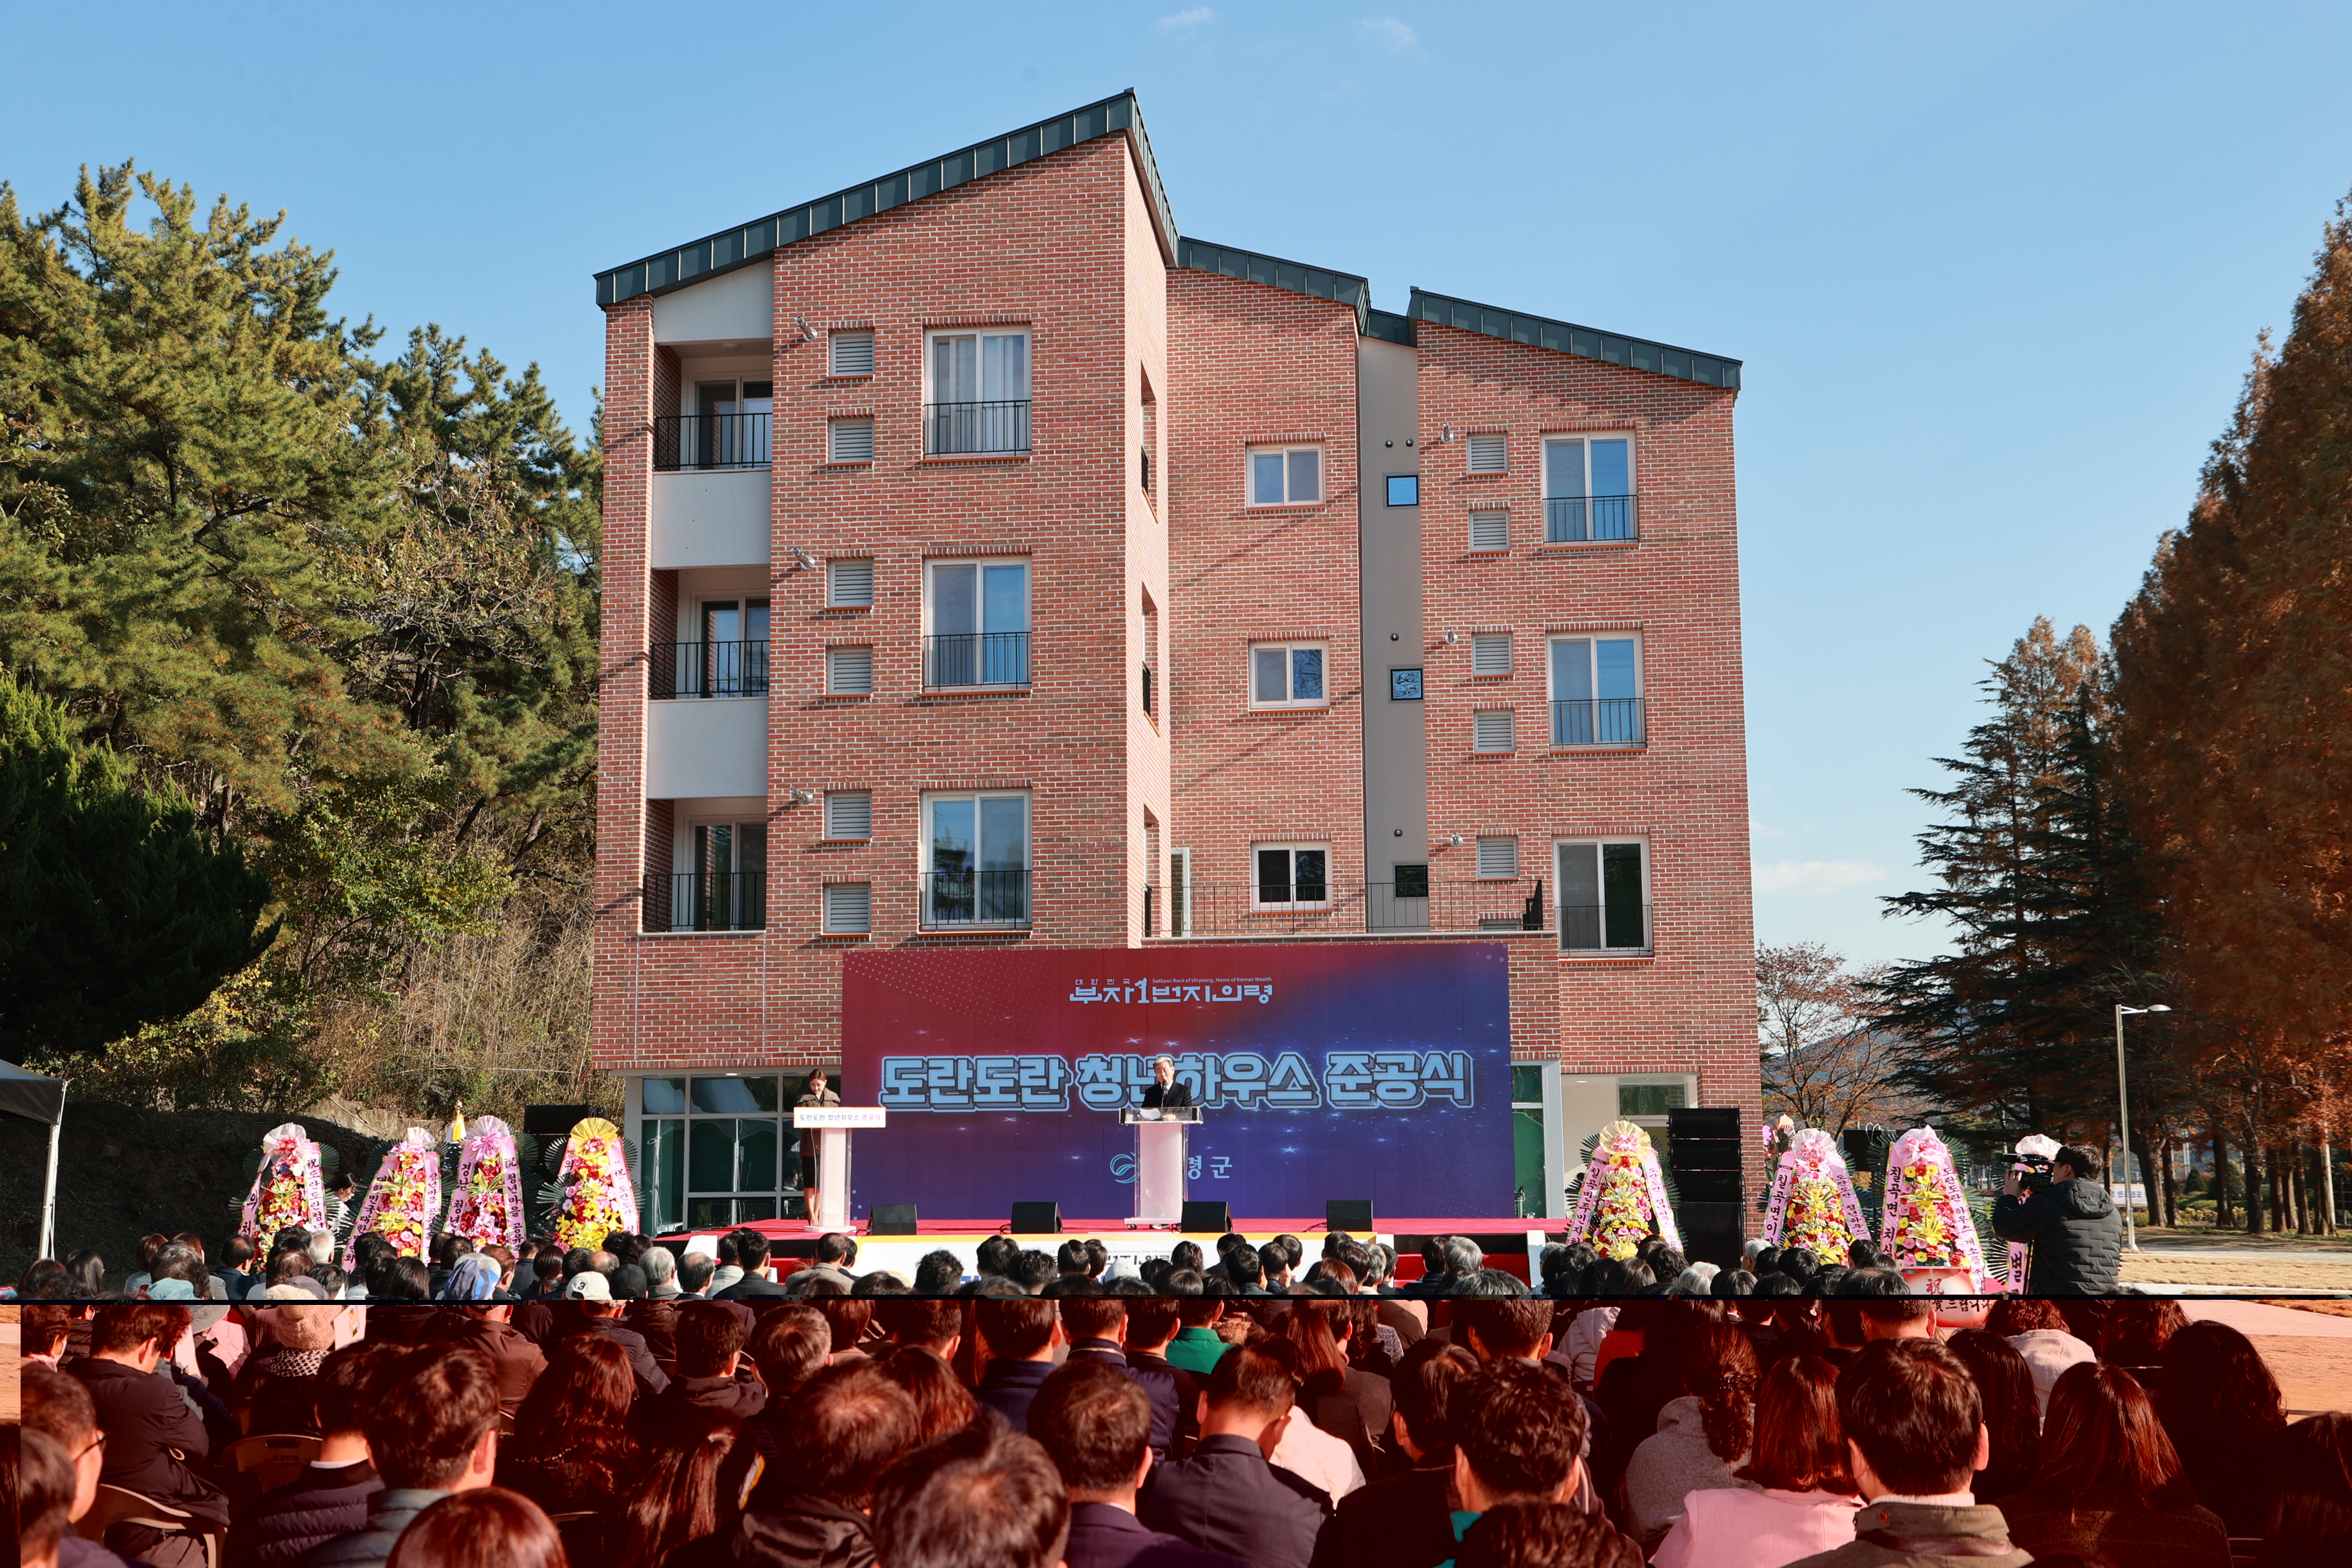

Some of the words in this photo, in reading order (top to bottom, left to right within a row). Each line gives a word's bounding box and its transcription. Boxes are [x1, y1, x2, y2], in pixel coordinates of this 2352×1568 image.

[878, 1055, 1074, 1112] 도란도란
[1324, 1050, 1475, 1109] 준공식
[504, 1157, 517, 1168] 祝
[1649, 1168, 1662, 1192] 도란도란
[506, 1173, 522, 1217] 청년마을
[618, 1186, 634, 1217] 도란도란
[1836, 1174, 1853, 1199] 도란도란
[1845, 1204, 1867, 1235] 청년하우스
[1886, 1166, 1902, 1217] 칠곡면
[449, 1199, 464, 1234] 청년
[1655, 1198, 1673, 1228] 청년하우스
[1942, 1168, 1962, 1202] 도란도란
[1955, 1206, 1973, 1233] 하우스
[1965, 1237, 1981, 1265] 개소를
